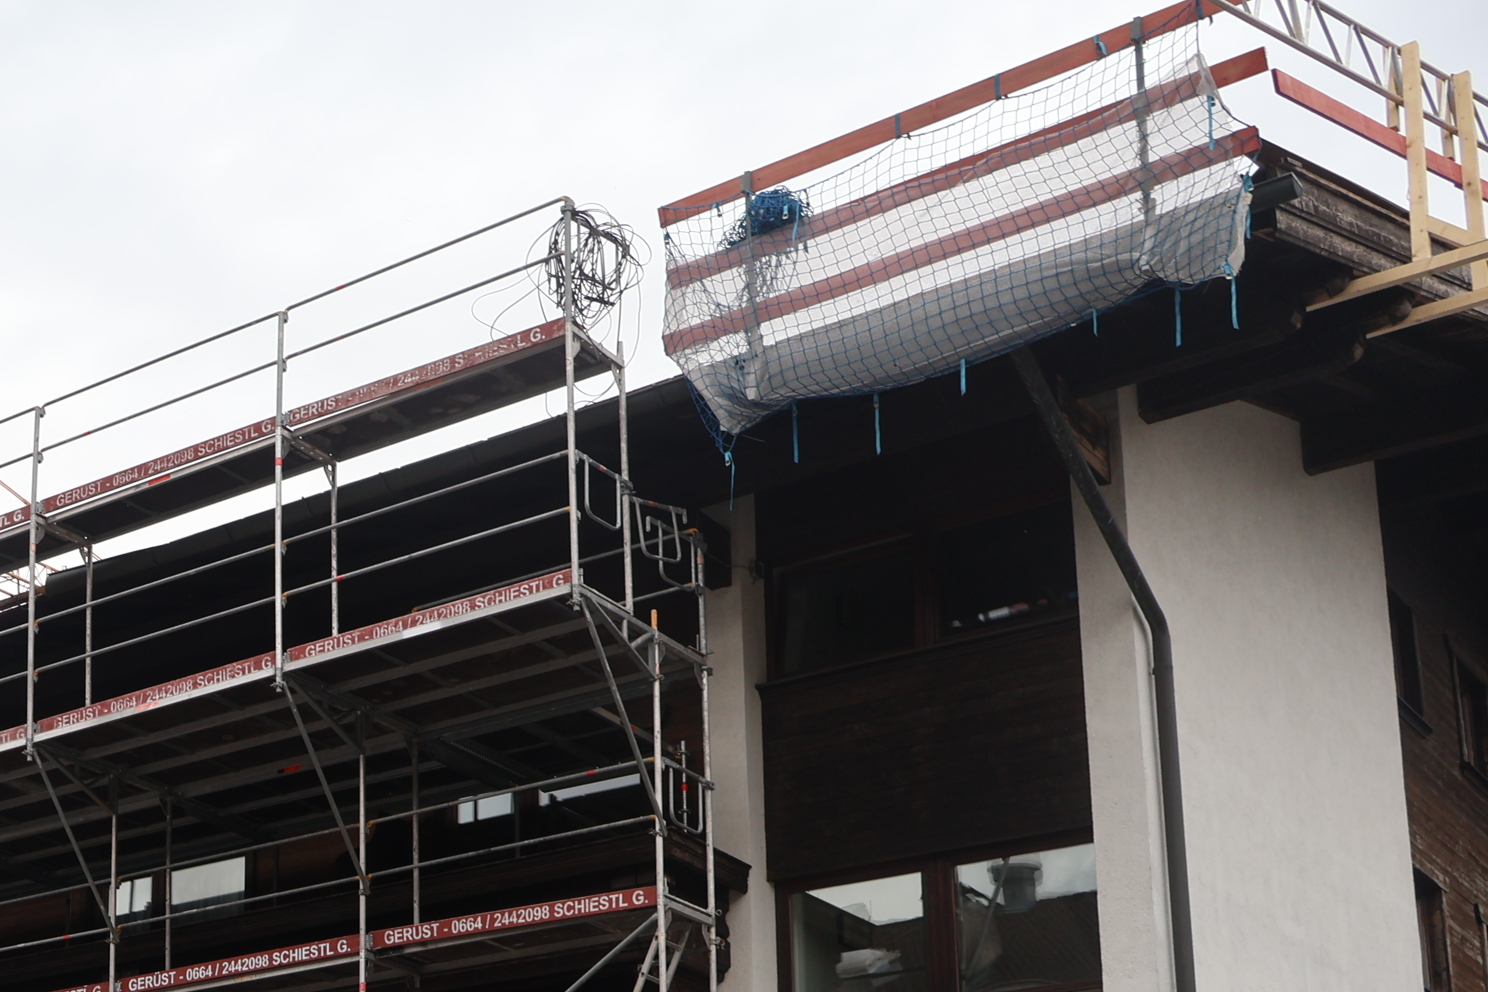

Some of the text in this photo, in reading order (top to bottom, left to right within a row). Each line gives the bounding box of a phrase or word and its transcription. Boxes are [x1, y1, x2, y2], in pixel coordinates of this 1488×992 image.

[112, 466, 138, 487] 0664
[148, 446, 193, 474] 2442098
[197, 423, 258, 457] SCHIESTL
[261, 417, 274, 434] G.
[13, 508, 24, 522] G.
[451, 915, 482, 933] 0664
[494, 904, 549, 927] 2442098
[554, 892, 628, 917] SCHIESTL
[632, 889, 648, 905] G.
[128, 938, 350, 991] GERÜST 0664 2442098 SCHIESTL G.
